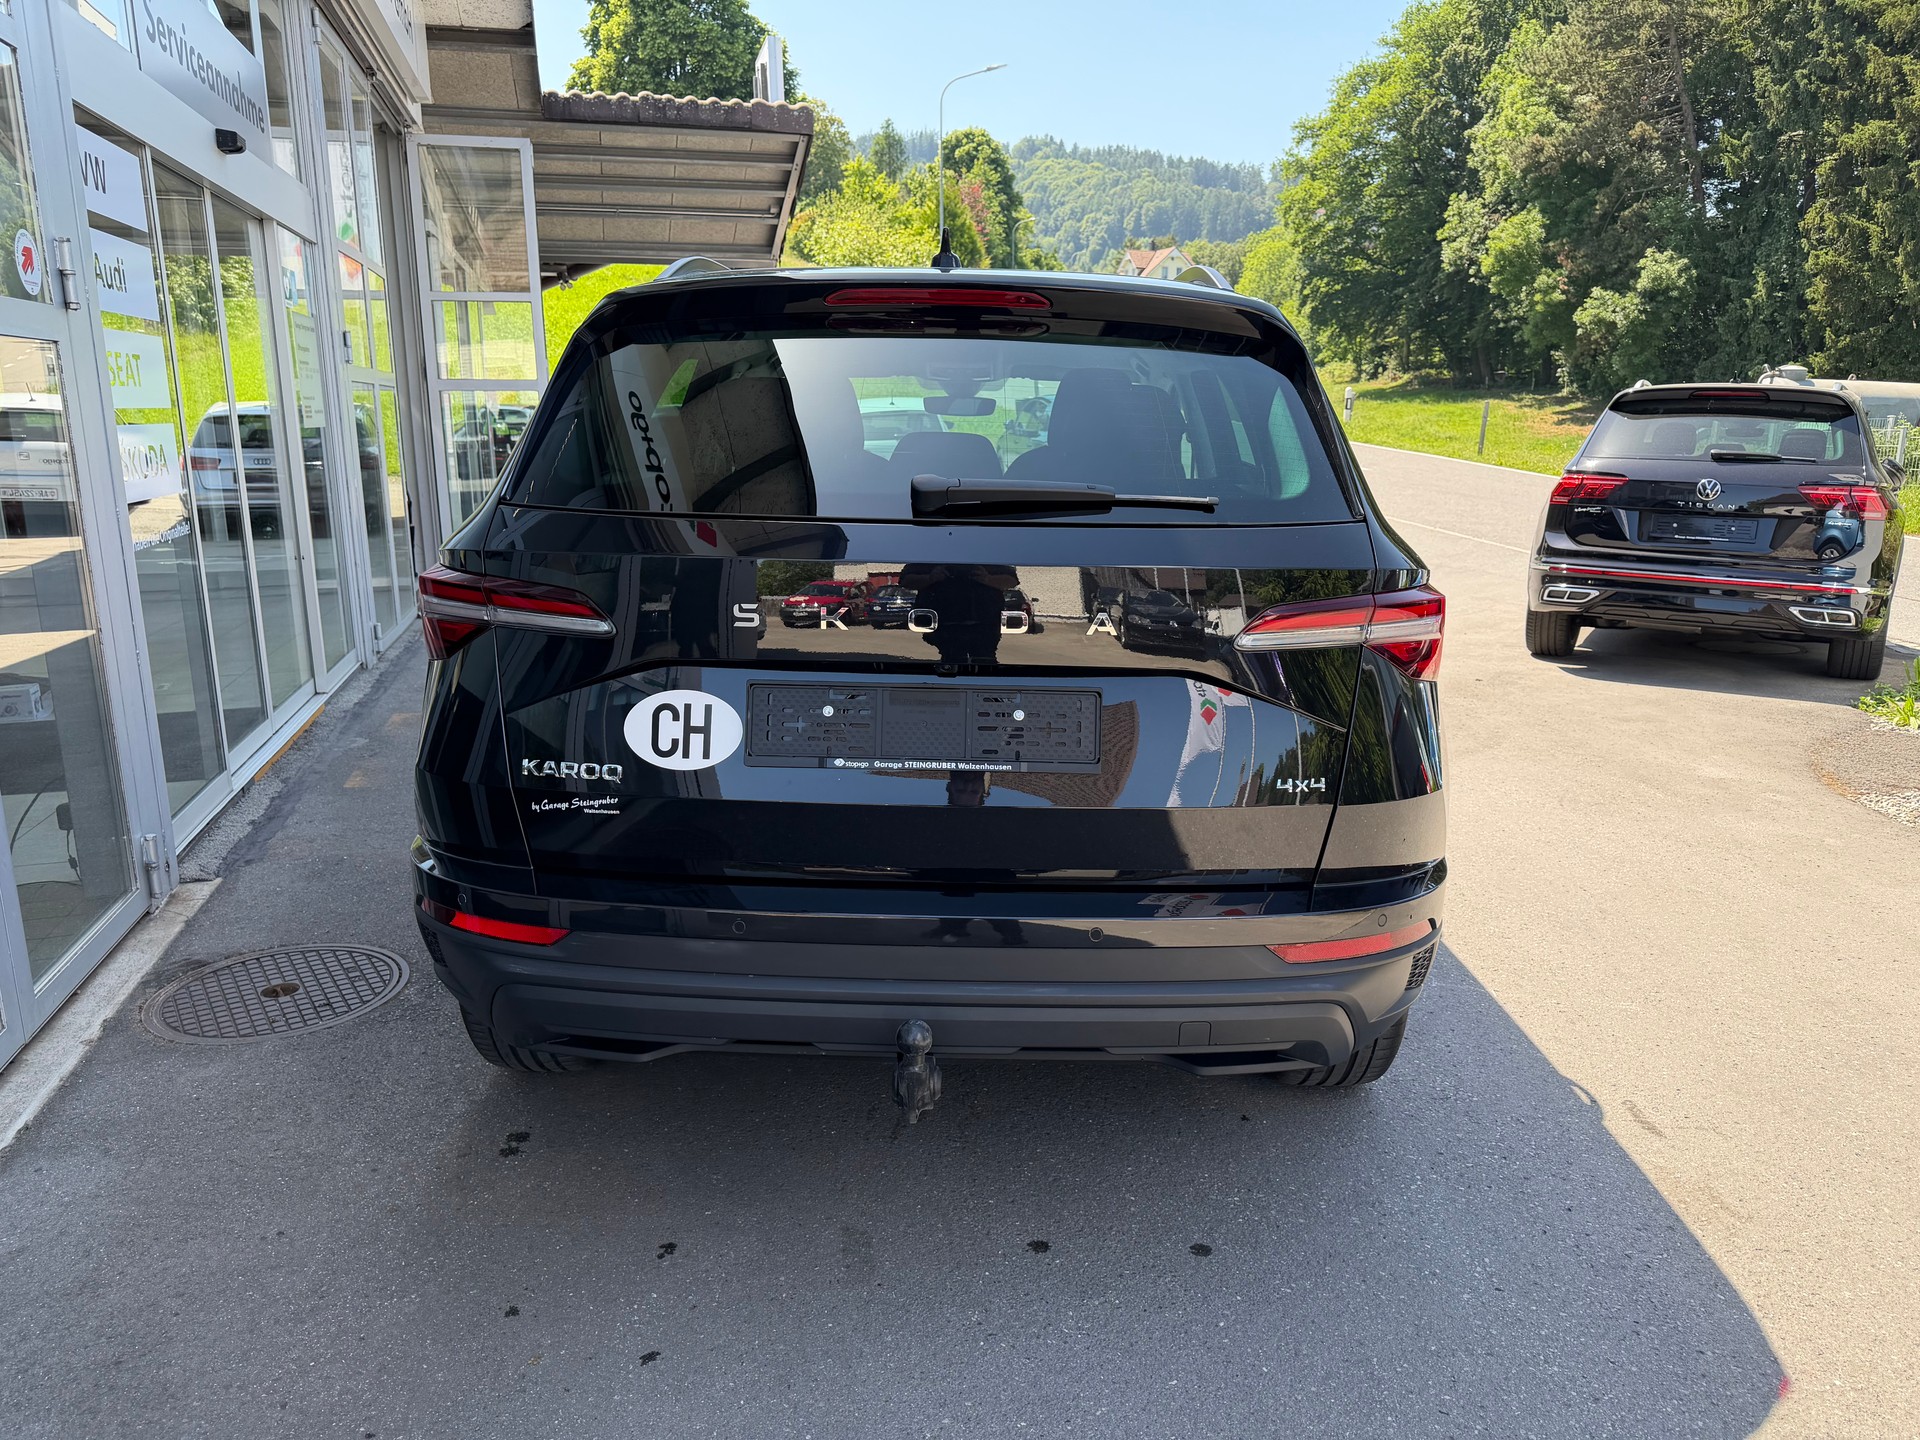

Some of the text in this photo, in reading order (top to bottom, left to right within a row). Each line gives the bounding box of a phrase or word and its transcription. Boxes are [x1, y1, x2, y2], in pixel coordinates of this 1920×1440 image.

[146, 0, 265, 134] Serviceannahme
[80, 151, 106, 194] VW
[94, 252, 127, 293] Audi
[107, 350, 141, 388] SEAT
[1677, 501, 1736, 510] TIGUAN
[651, 702, 713, 760] CH
[521, 758, 623, 784] KAROQ
[874, 760, 903, 769] Garage
[904, 761, 956, 770] STEINGRUBER
[957, 762, 1012, 771] Walzenhausen
[1276, 777, 1326, 793] 4x4
[531, 795, 618, 812] by Garage Steingruber
